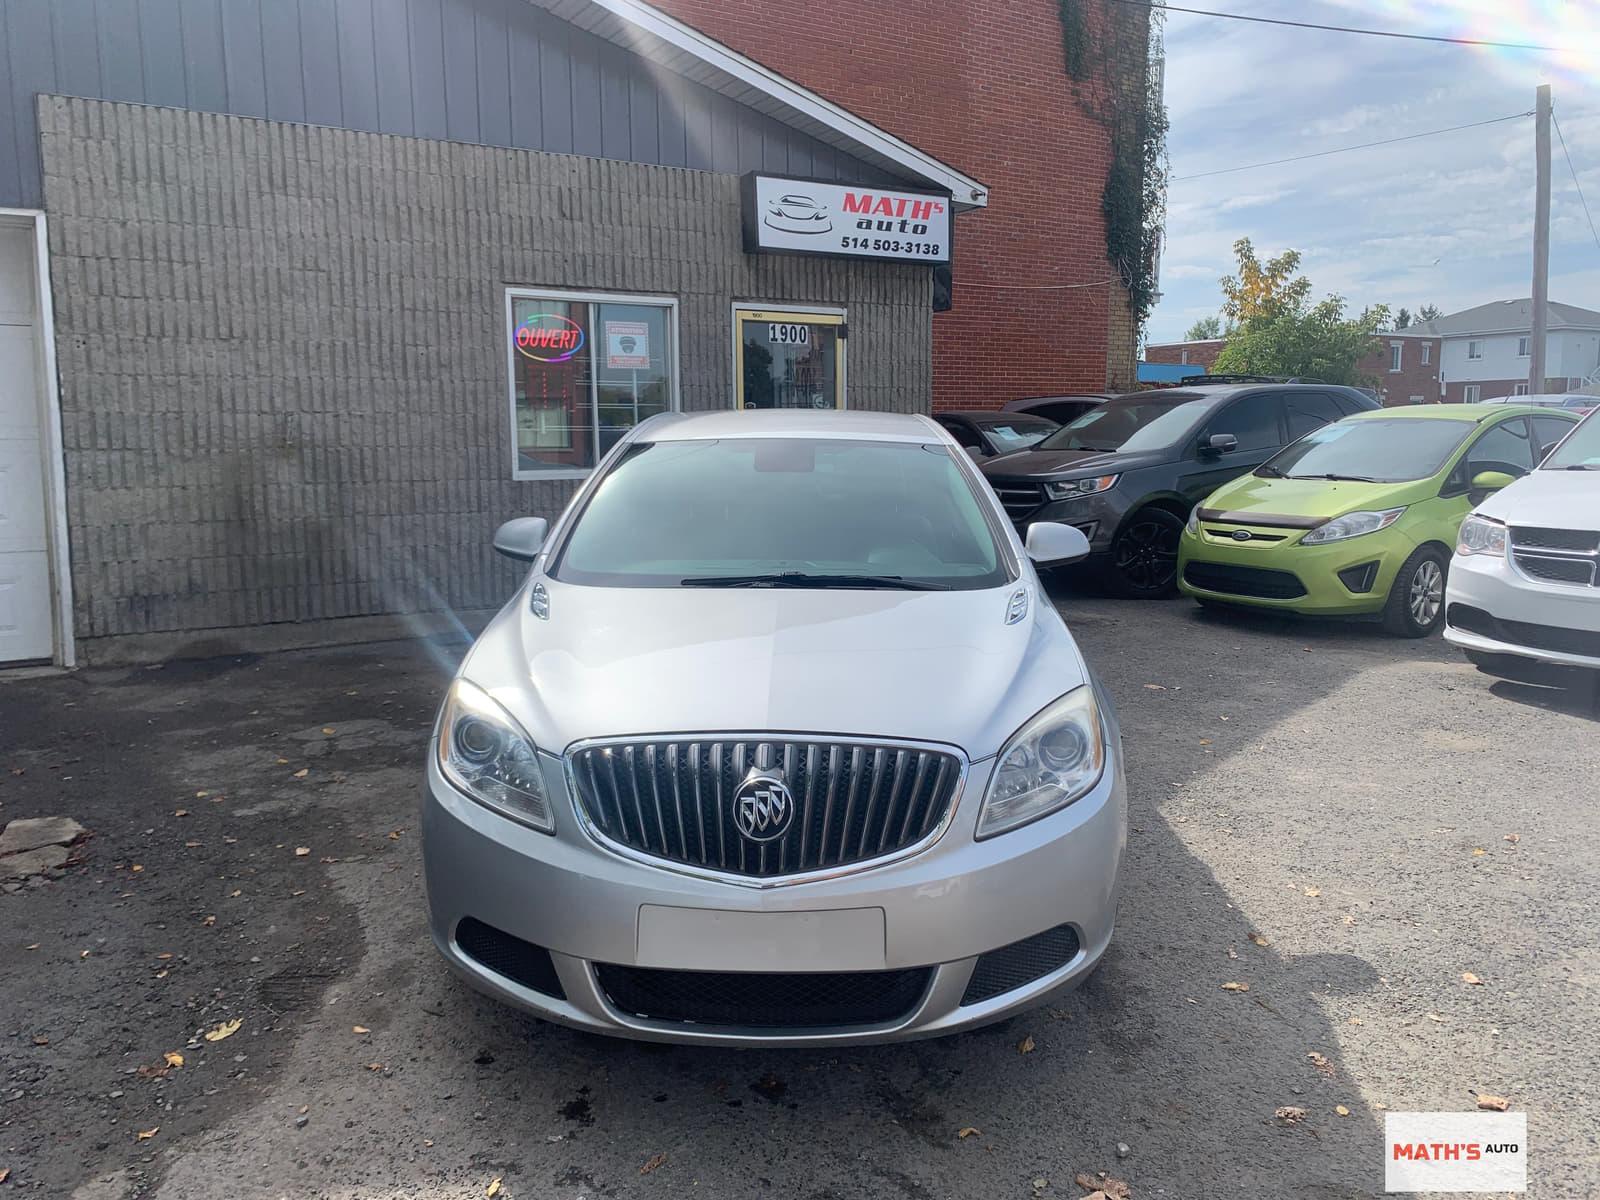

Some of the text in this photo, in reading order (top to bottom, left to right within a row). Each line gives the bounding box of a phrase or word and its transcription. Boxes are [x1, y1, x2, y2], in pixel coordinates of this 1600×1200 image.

[856, 218, 928, 235] auto
[841, 236, 940, 256] 514 503-3138
[517, 327, 579, 349] OUVERT
[770, 324, 807, 343] 1900
